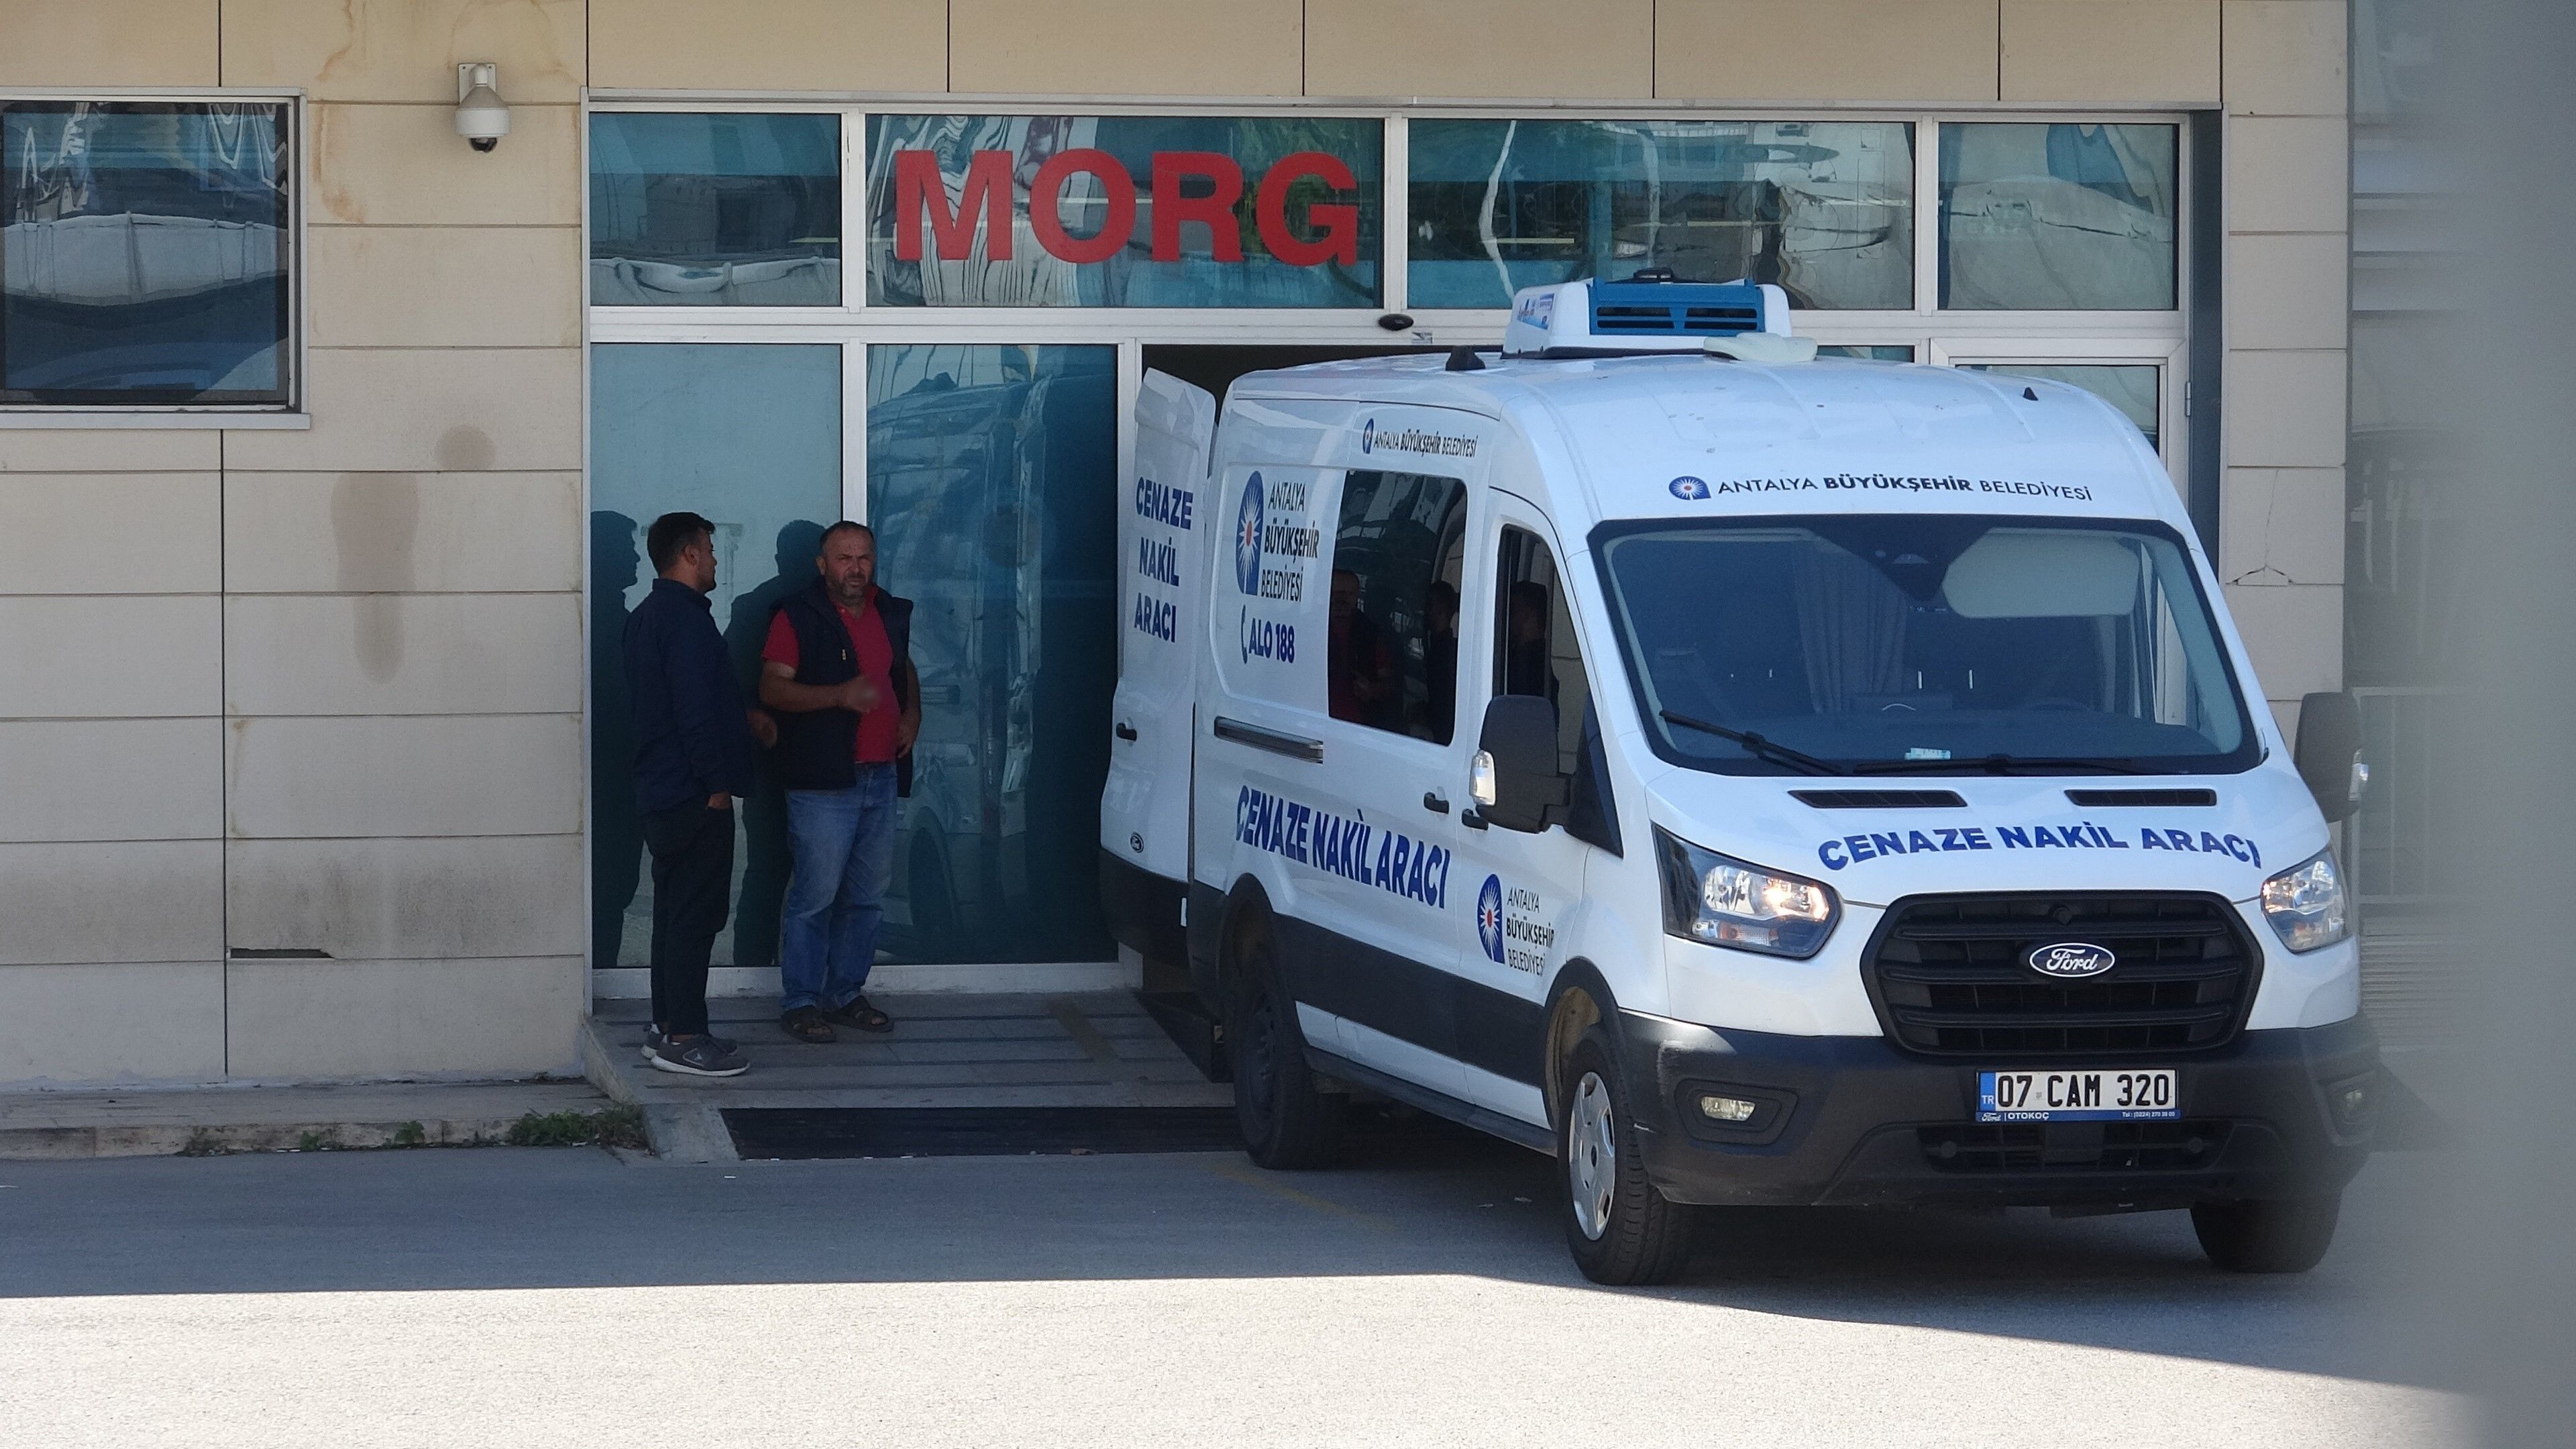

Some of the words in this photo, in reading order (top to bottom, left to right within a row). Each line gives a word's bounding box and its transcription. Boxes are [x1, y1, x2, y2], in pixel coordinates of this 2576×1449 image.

[896, 148, 1358, 266] MORG
[1374, 431, 1399, 450] ANTALYA
[1136, 476, 1193, 530] CENAZE
[1268, 482, 1306, 512] ANTALYA
[1718, 478, 1817, 495] ANTALYA
[1824, 474, 1974, 492] BÜYÜKŞEHİR
[1980, 480, 2092, 502] BELEDİYESİ
[1265, 518, 1320, 564] BÜYÜKŞEHİR
[1139, 537, 1179, 587] NAKİL
[1261, 565, 1303, 602] BELEDİYESİ
[1134, 592, 1175, 643] ARACI
[1248, 617, 1272, 659] ALO
[1275, 623, 1295, 663] 188
[1236, 785, 1311, 864] CENAZE
[1376, 830, 1450, 909] ARACI
[1818, 827, 1992, 871] CENAZE
[1996, 820, 2130, 849] NAKİL
[2141, 827, 2261, 869] ARACI
[1507, 887, 1540, 913] ANTALYA
[1506, 913, 1554, 949] BÜYÜKŞEHİR
[1508, 949, 1545, 977] BELEDİYESİ
[2046, 947, 2098, 971] Ford
[1982, 1095, 1994, 1104] TR
[1998, 1075, 2033, 1107] 07
[2048, 1075, 2100, 1107] CAM
[2117, 1074, 2169, 1106] 320
[1982, 1112, 2001, 1122] Ford
[2008, 1112, 2049, 1121] OTOKOÇ
